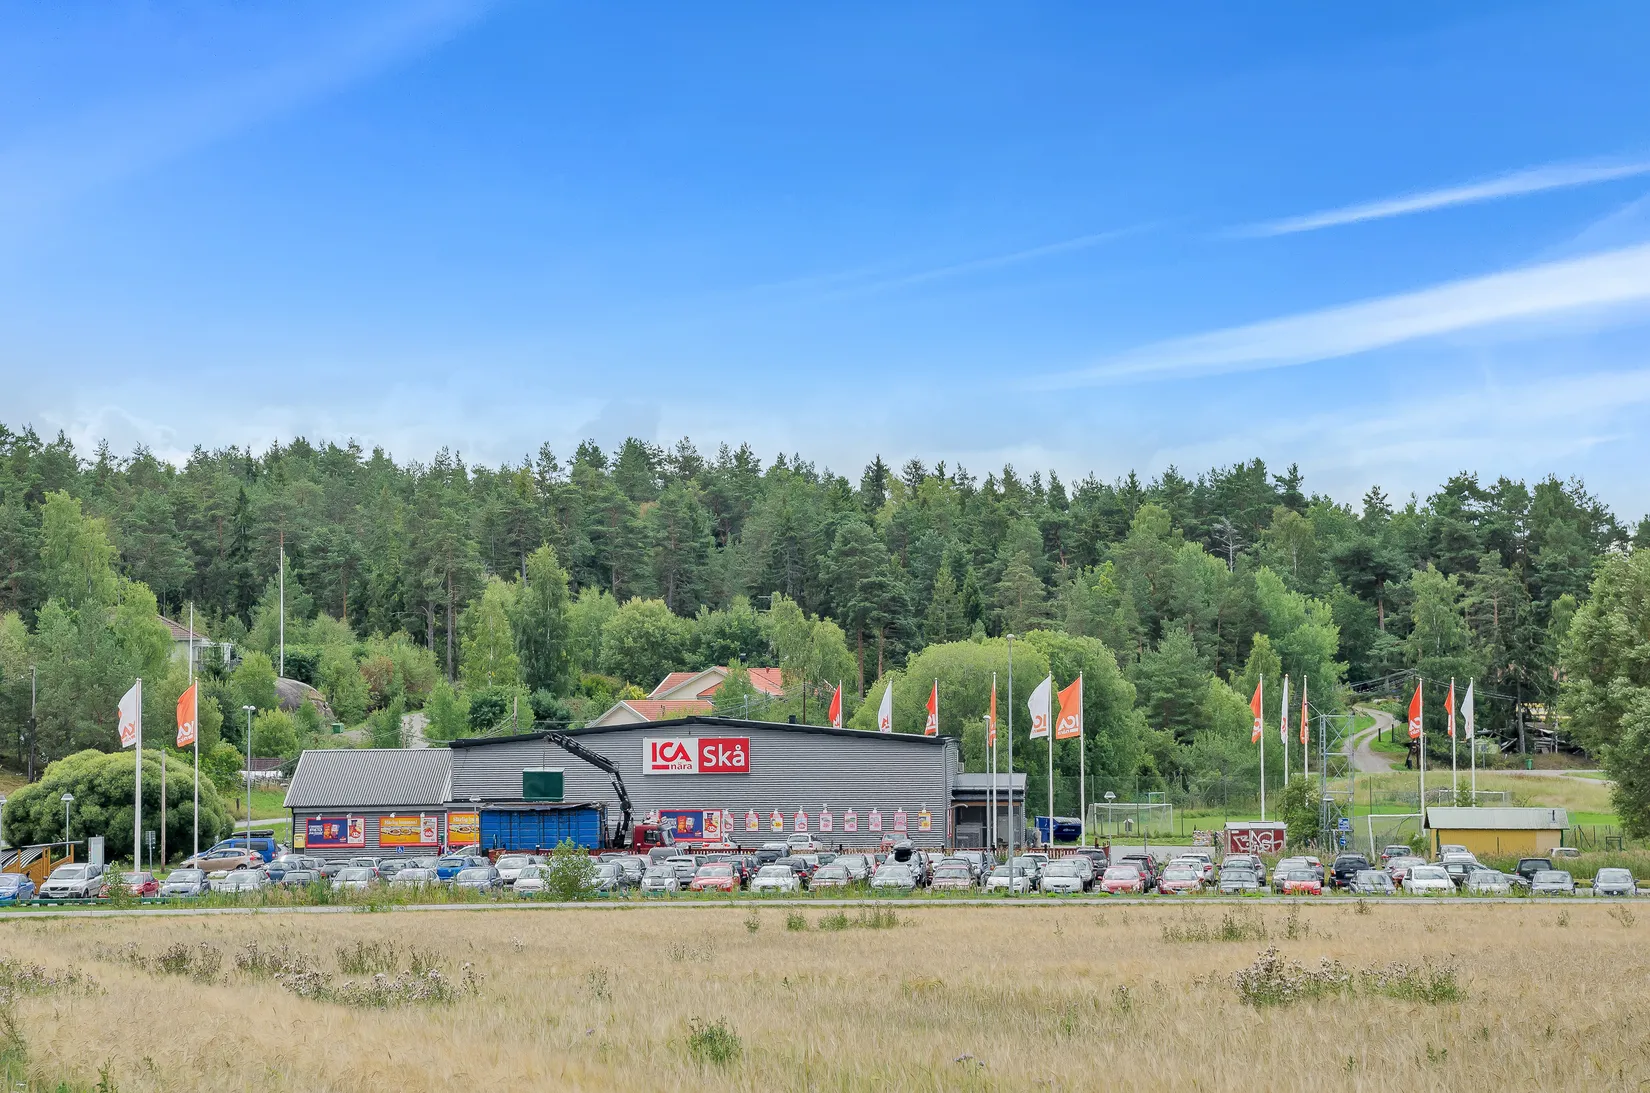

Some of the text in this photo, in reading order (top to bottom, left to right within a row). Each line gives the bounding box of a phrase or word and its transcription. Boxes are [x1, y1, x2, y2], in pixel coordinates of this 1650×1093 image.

[651, 741, 692, 763] ICA
[702, 743, 746, 767] Skå
[671, 762, 693, 770] nära
